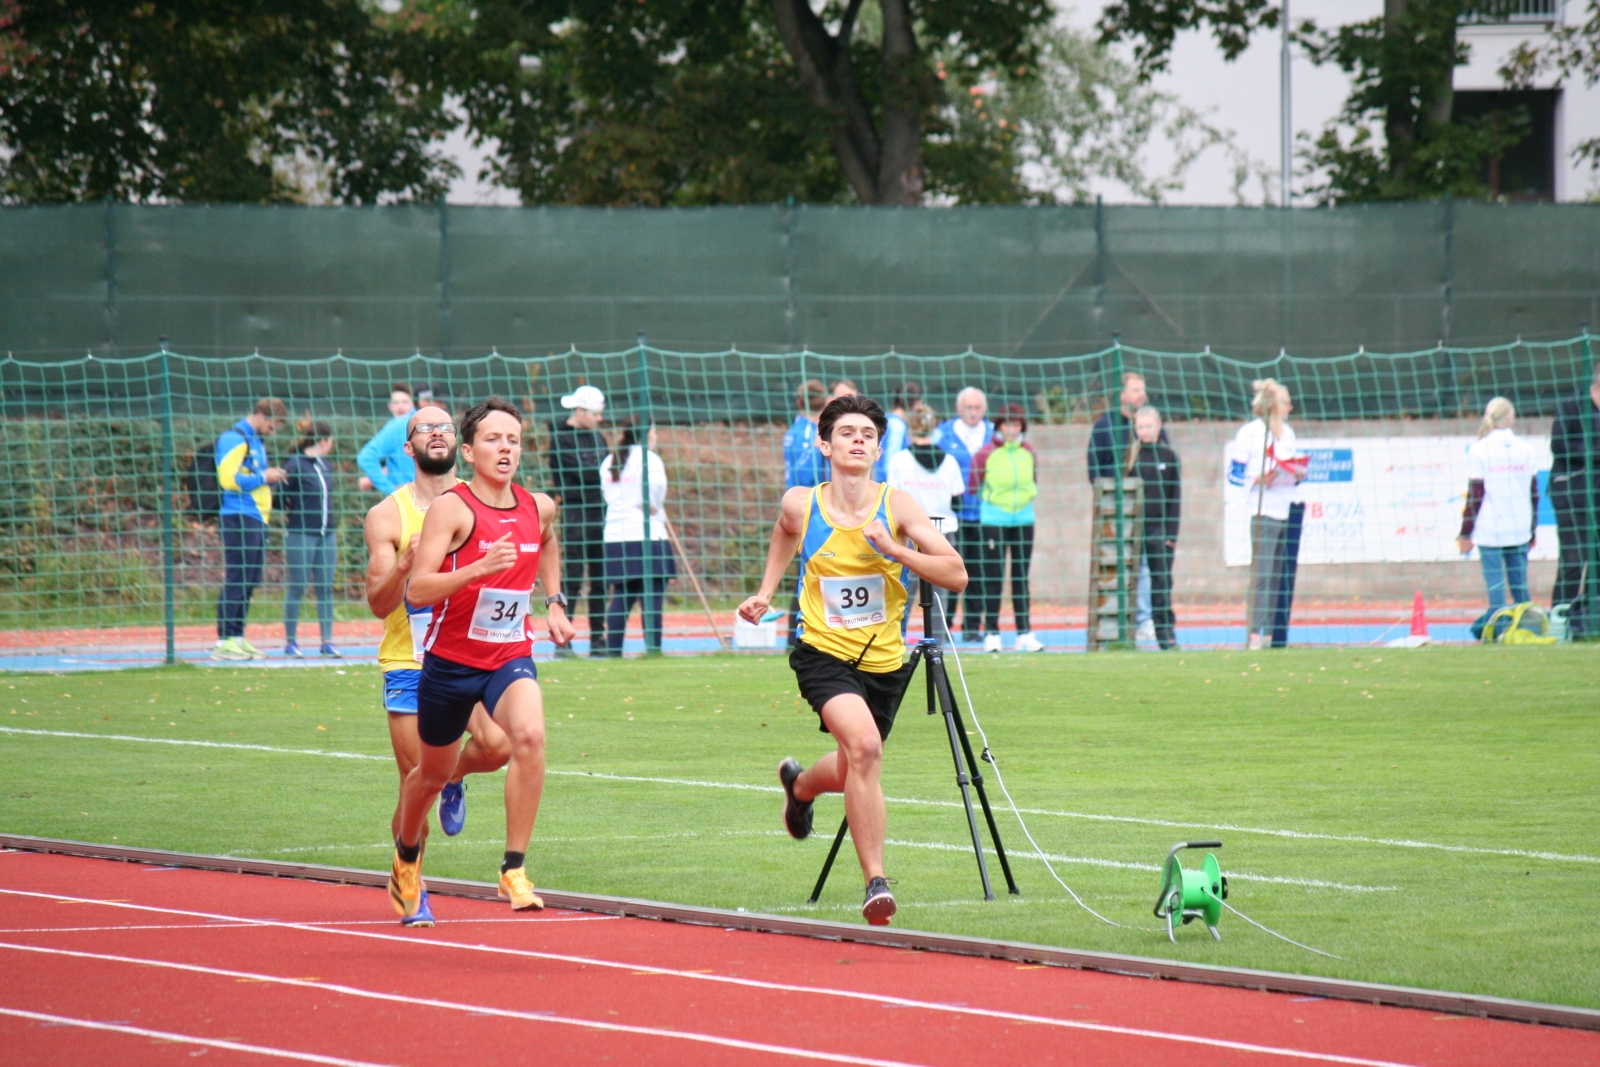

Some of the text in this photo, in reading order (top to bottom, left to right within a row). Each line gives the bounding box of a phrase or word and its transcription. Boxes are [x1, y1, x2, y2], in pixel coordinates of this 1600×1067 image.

[841, 586, 869, 609] 39
[490, 600, 519, 621] 34
[844, 616, 869, 624] TRUTNOV
